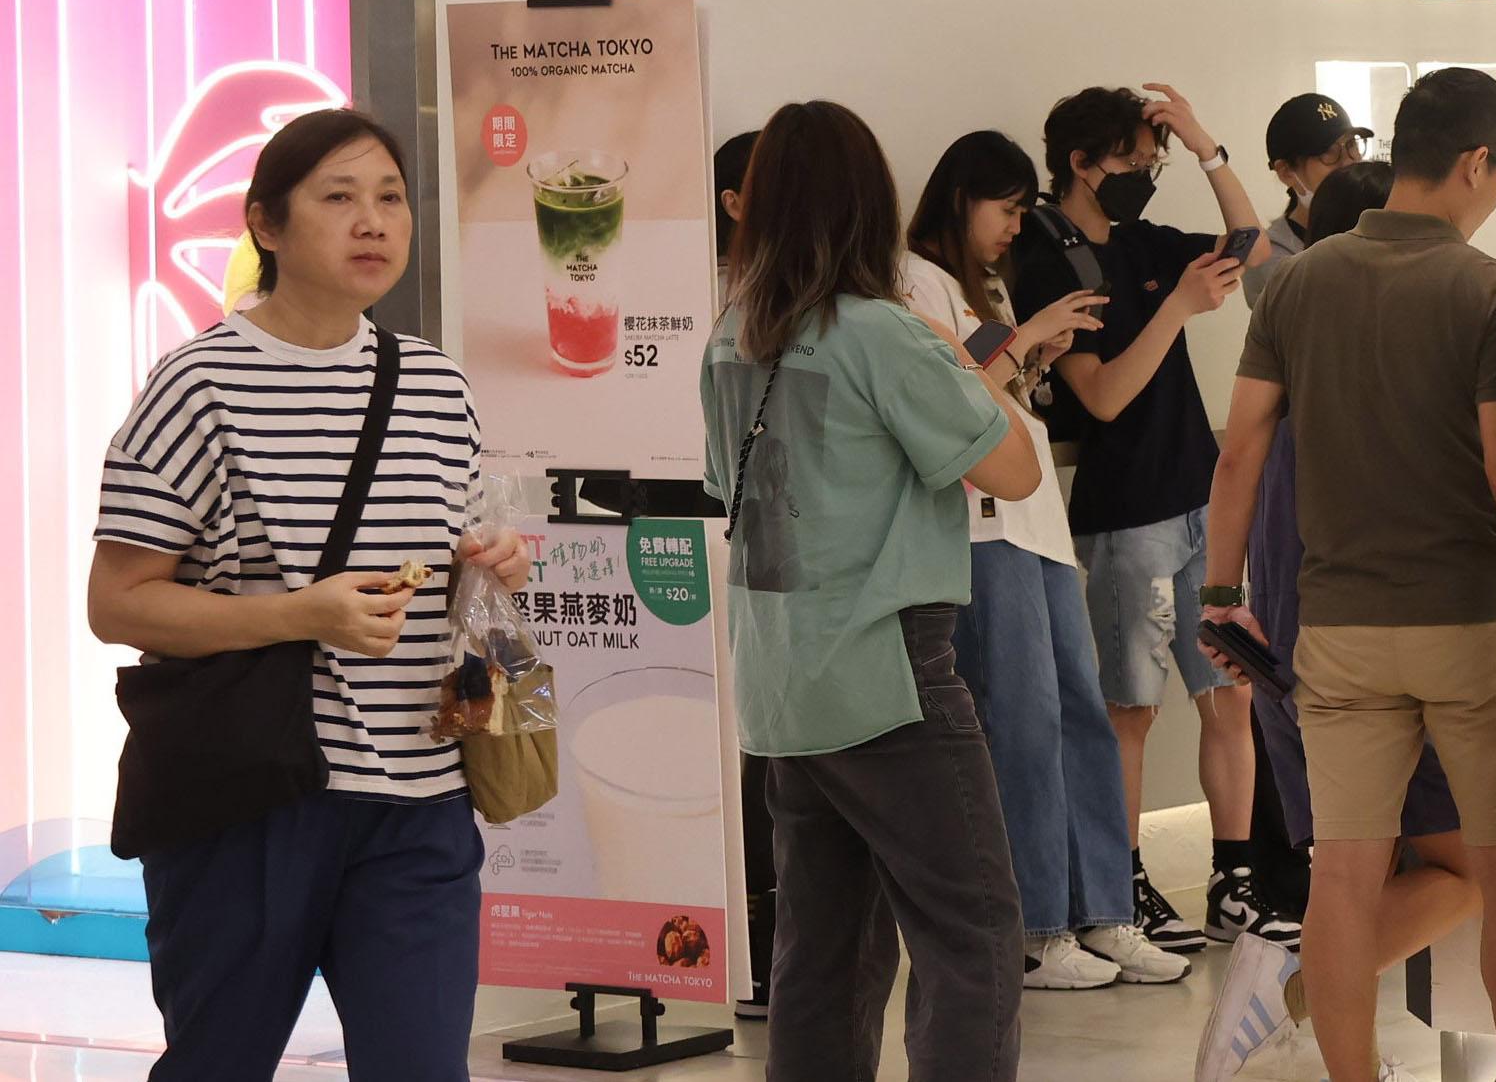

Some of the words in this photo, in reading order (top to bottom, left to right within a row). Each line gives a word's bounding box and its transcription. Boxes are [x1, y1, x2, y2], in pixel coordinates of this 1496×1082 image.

[490, 44, 518, 60] THE
[523, 41, 592, 59] MATCHA
[597, 38, 653, 56] TOKYO
[510, 66, 538, 77] 100%
[541, 64, 588, 76] ORGANIC
[591, 63, 635, 75] MATCHA
[492, 116, 516, 131] 期間
[492, 133, 517, 148] 限定
[575, 254, 589, 263] THE
[566, 264, 598, 272] MATCHA
[570, 273, 596, 282] TOKYO
[624, 316, 694, 332] 櫻花抹茶鮮奶
[624, 344, 659, 367] $52
[641, 557, 658, 567] FREE
[659, 557, 695, 568] UPGRADE
[567, 631, 598, 648] OAT
[603, 632, 640, 650] MILK
[628, 971, 644, 982] THE
[645, 972, 681, 985] MATCHA
[684, 975, 713, 988] TOKYO
